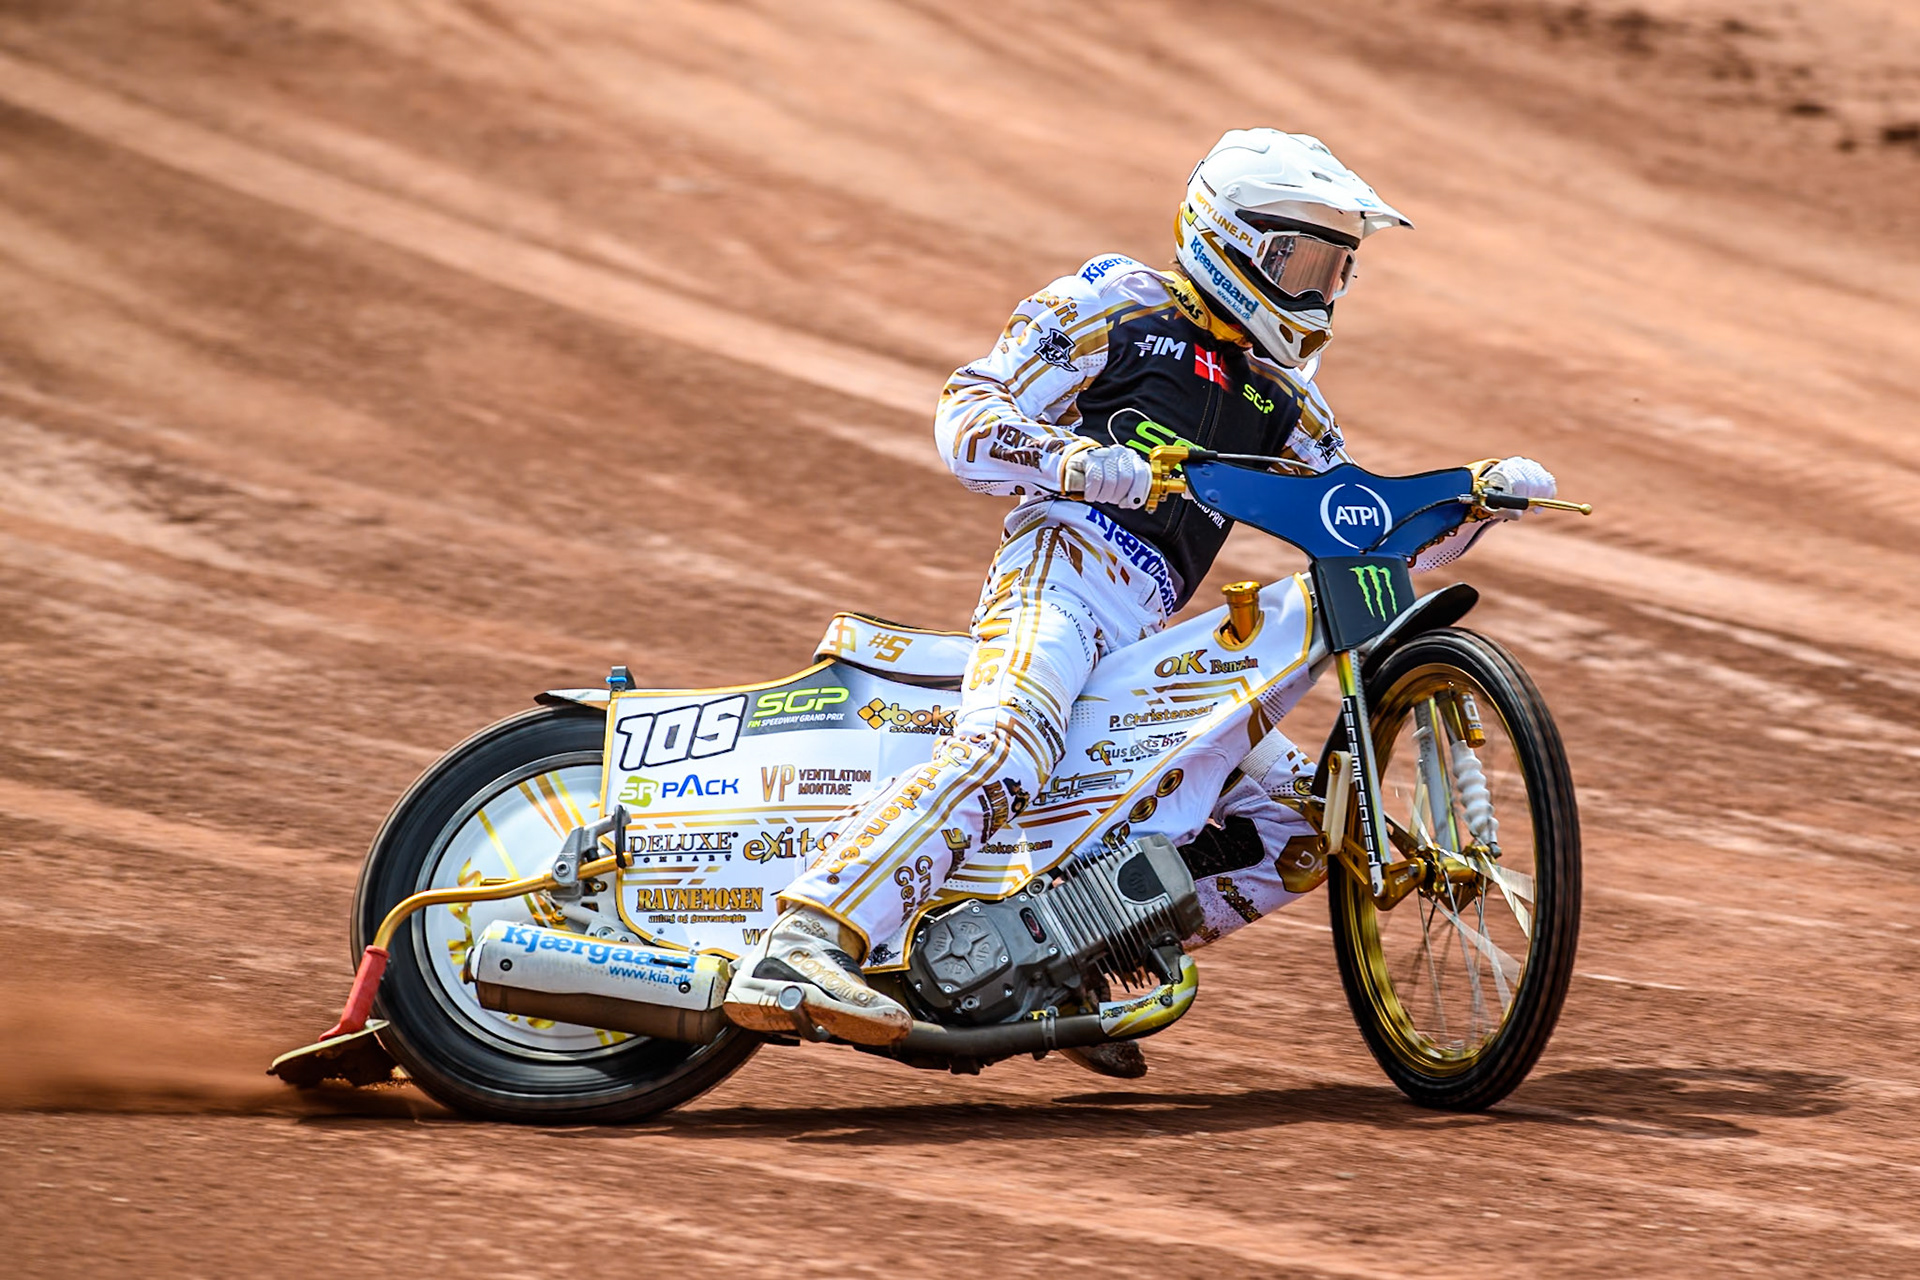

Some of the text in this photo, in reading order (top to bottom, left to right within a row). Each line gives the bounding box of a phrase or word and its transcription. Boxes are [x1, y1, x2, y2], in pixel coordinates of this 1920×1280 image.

[1190, 235, 1260, 314] Kjærgaard
[1134, 334, 1187, 360] FIM
[1335, 505, 1380, 527] ATPI
[868, 632, 914, 663] #5
[1154, 649, 1208, 678] OK
[1209, 655, 1259, 674] Benzin
[752, 686, 850, 718] SGP
[747, 712, 845, 729] FIM SPEEDWAY GRAND PRIX
[1109, 703, 1216, 728] P. Christensen
[616, 693, 749, 771] 105
[661, 774, 739, 798] PACK
[761, 764, 796, 802] VP
[799, 769, 872, 783] VENTILATION
[798, 783, 852, 795] MONTAGE
[827, 742, 973, 875] Christensen
[629, 831, 733, 853] DELUXE
[637, 887, 764, 911] RAVNEMOSEN
[501, 925, 699, 973] Kjærgaard
[609, 964, 692, 986] www.kia.dk
